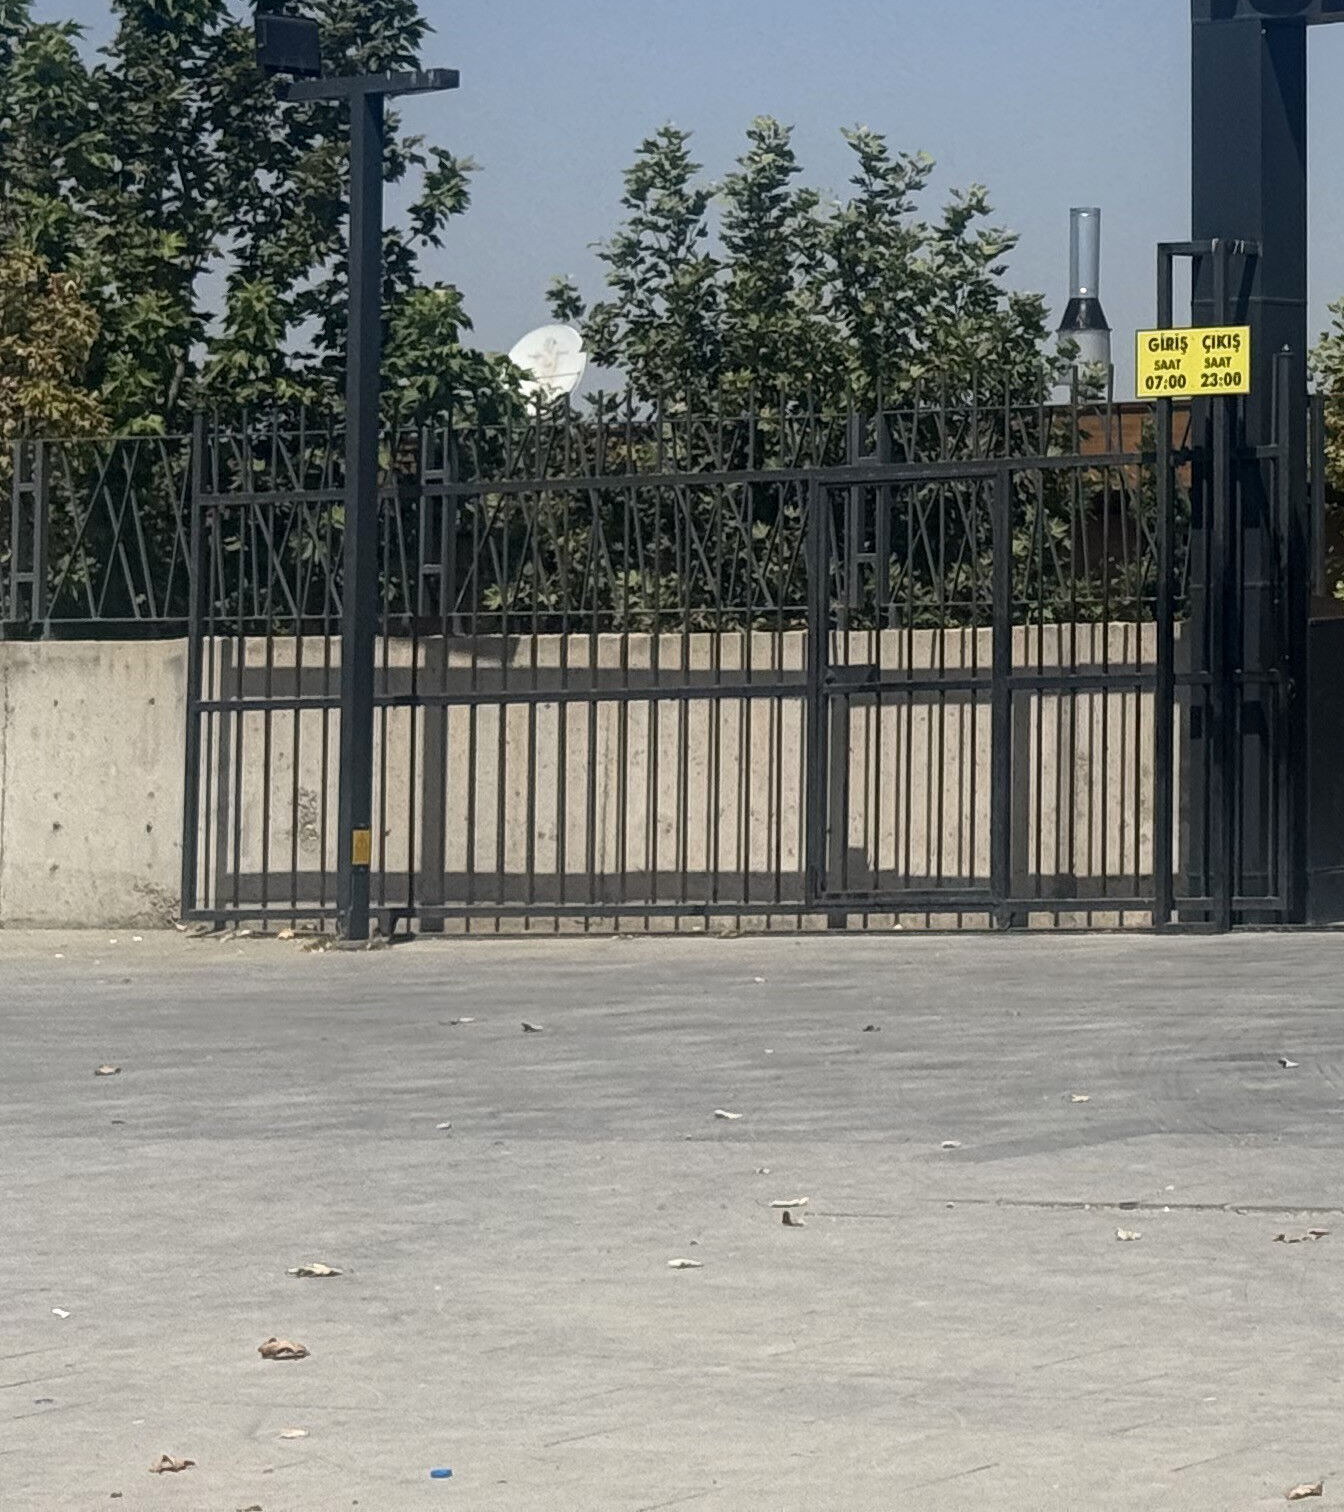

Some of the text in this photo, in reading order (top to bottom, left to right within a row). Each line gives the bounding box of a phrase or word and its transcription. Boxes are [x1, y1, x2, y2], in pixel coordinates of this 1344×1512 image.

[1148, 333, 1241, 355] GİRİŞ ÇIKIŞ
[1154, 357, 1232, 371] SAAT SAAT
[1145, 372, 1241, 390] 07:00 23:00
